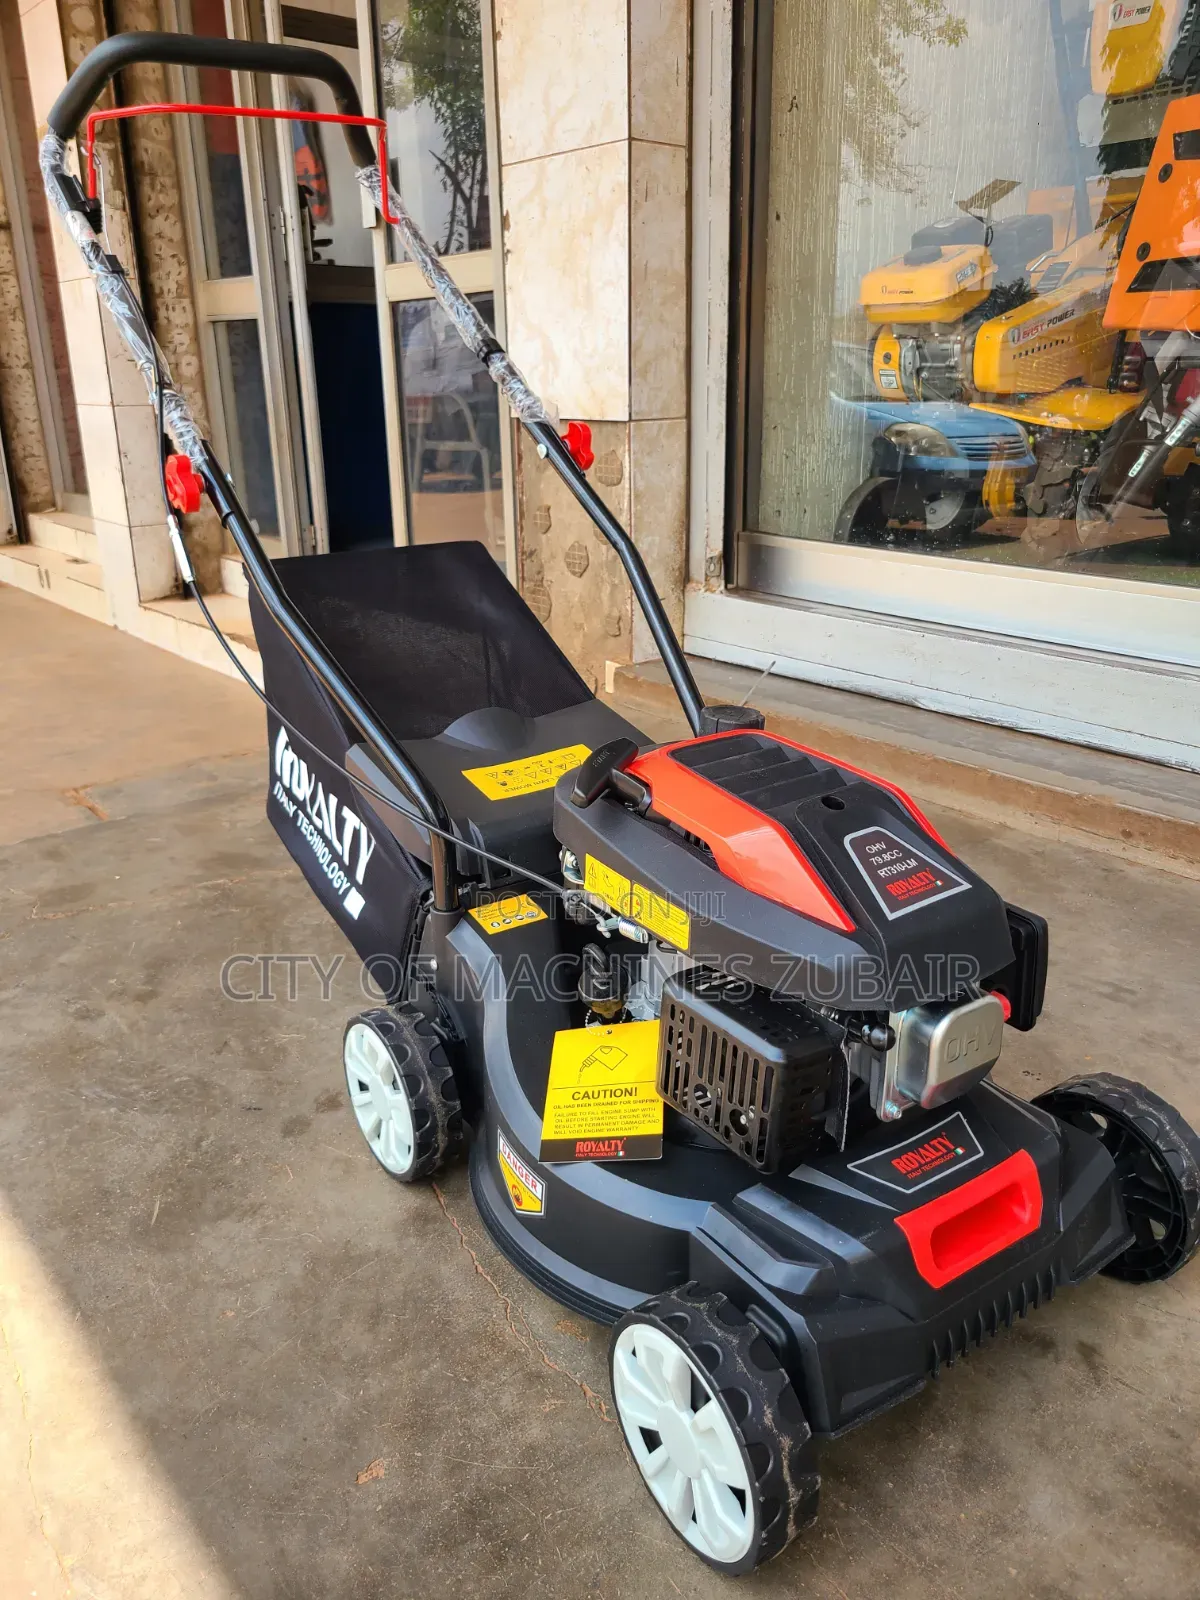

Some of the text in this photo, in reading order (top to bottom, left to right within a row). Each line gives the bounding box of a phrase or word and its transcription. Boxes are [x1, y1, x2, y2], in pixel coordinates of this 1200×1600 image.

[1123, 8, 1135, 18] EASY
[1022, 309, 1075, 339] EASY POWER
[273, 781, 350, 896] ITALY TECHNOLOGY
[865, 841, 887, 854] OHV
[869, 850, 903, 866] 79.8CC
[877, 858, 919, 879] RT310-LM
[886, 872, 936, 896] ROYALTY
[944, 1024, 996, 1063] OHV
[572, 1087, 638, 1101] CAUTION!
[576, 1140, 624, 1152] ROYALTY
[891, 1136, 955, 1174] ROYALTY
[502, 1142, 538, 1193] DANGER
[907, 1152, 956, 1179] ITALY TECHNOLOGY
